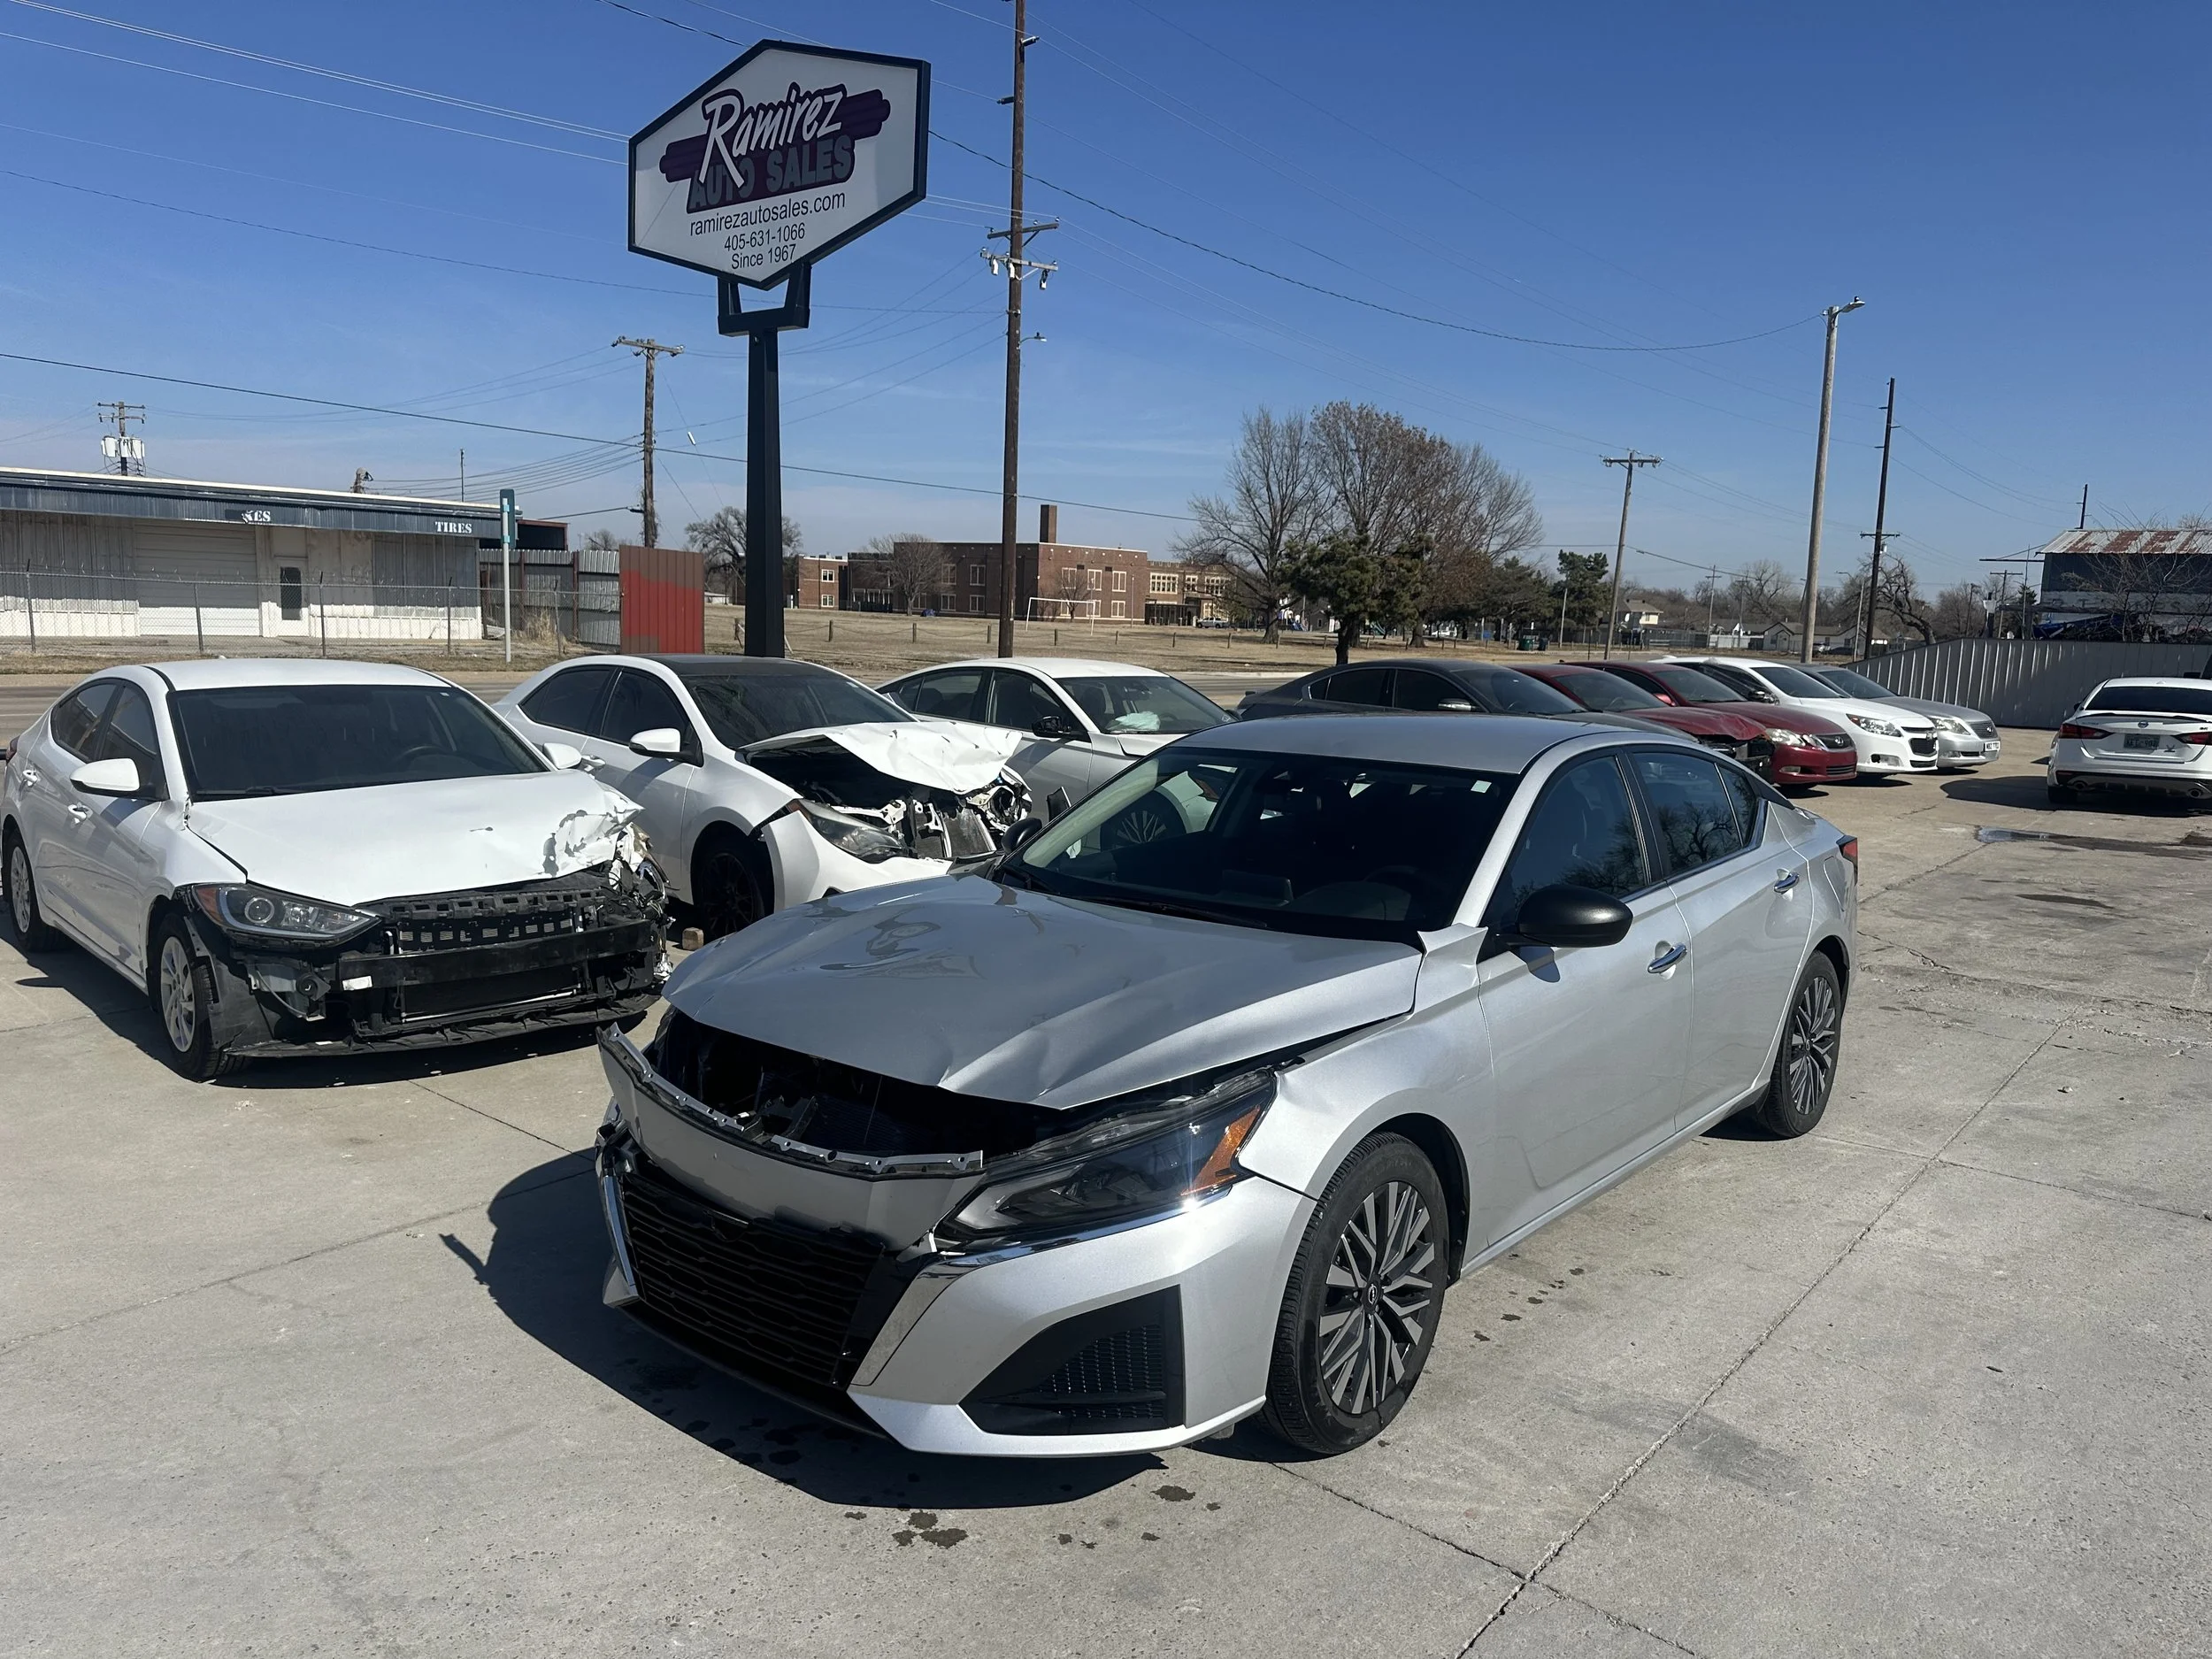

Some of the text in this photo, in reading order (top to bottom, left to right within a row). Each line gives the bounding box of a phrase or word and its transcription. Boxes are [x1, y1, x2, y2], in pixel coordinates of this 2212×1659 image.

[698, 88, 843, 188] Ramirez
[766, 134, 852, 193] SALES
[690, 192, 846, 236] ramirezautosales.com
[724, 222, 805, 251] 405-631-1066
[731, 243, 796, 270] Since 1967
[434, 521, 472, 534] TIRES
